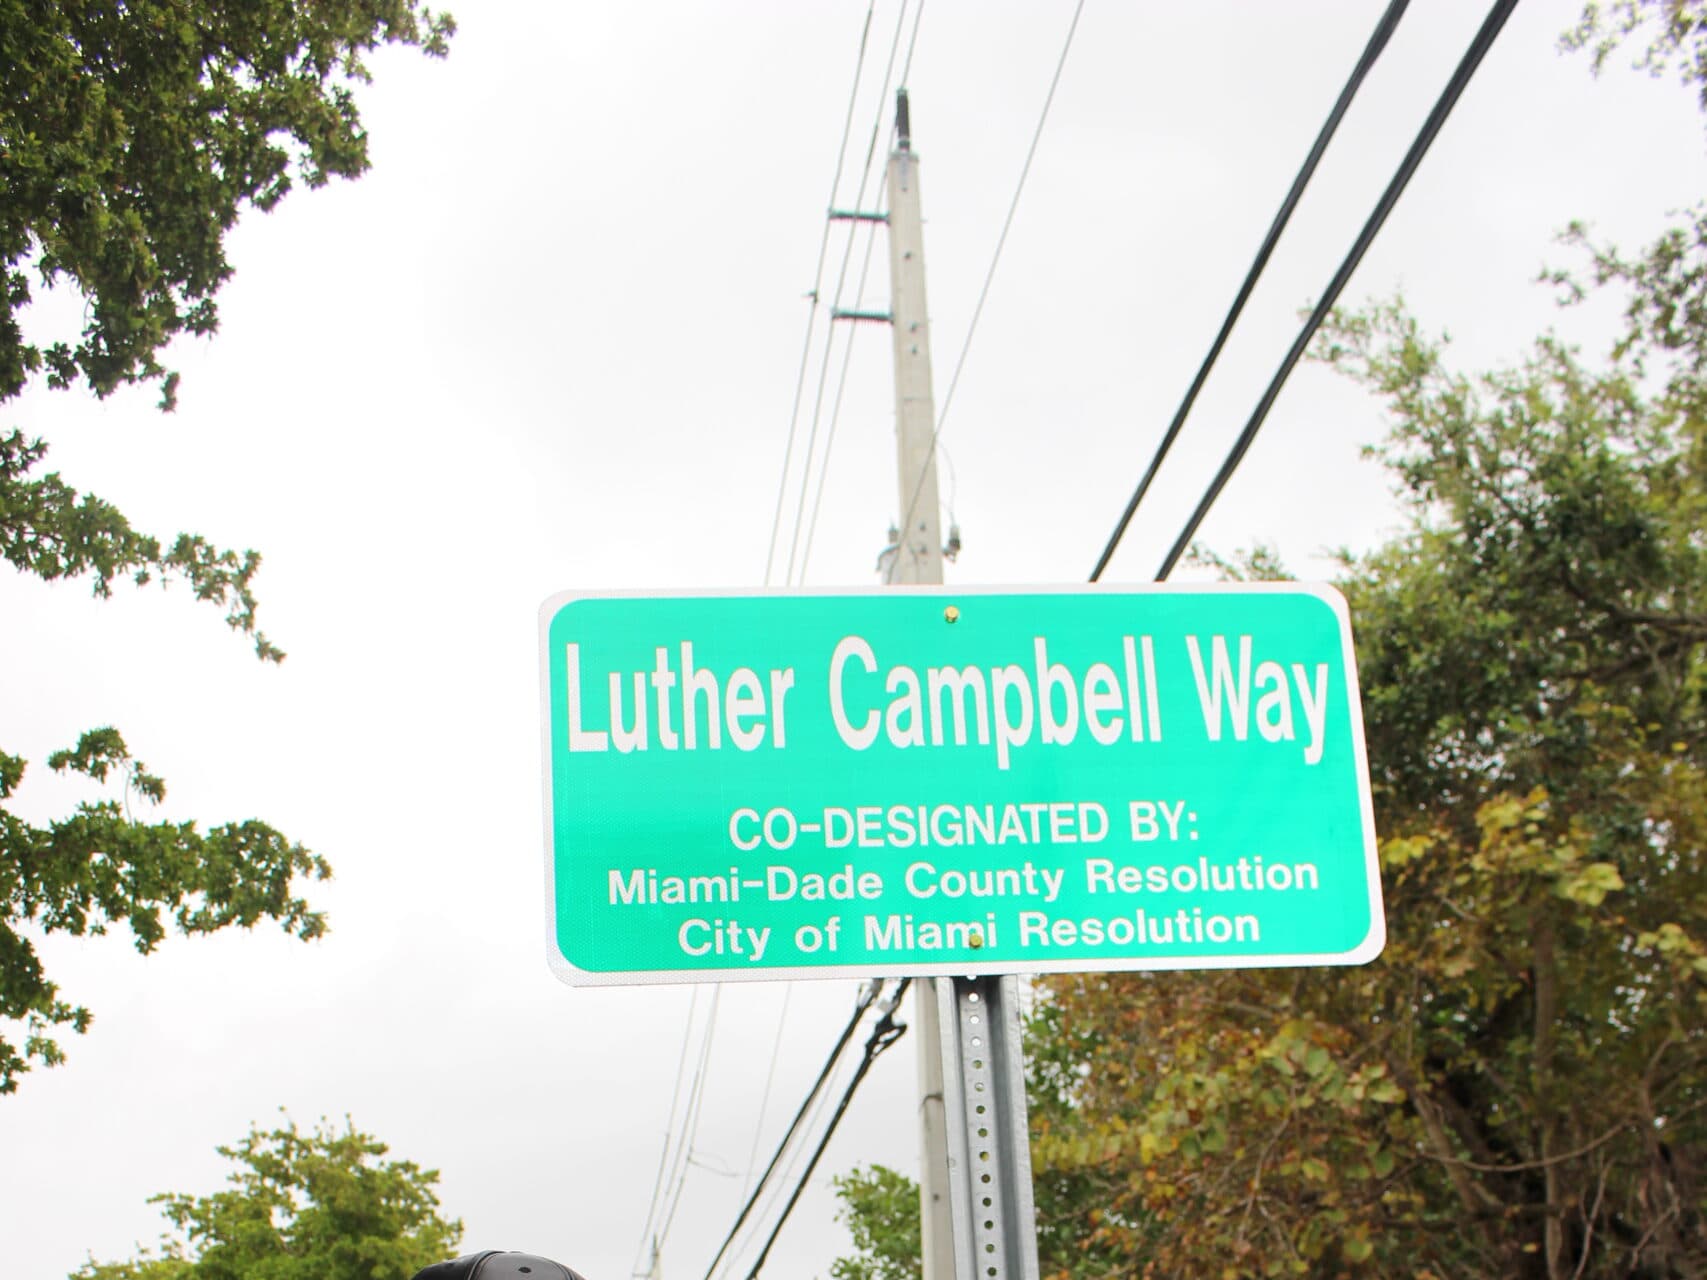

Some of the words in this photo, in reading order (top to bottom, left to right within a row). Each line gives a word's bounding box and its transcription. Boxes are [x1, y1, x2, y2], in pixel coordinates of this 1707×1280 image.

[567, 641, 794, 753] Luther
[829, 636, 1161, 769] Campbell
[1186, 635, 1328, 764] Way
[730, 802, 1108, 850] CO-DESIGNATED
[1130, 801, 1198, 841] BY:
[609, 865, 882, 904] Miami-Dade
[905, 862, 1064, 901] County
[1086, 856, 1318, 893] Resolution
[679, 919, 770, 960] City
[795, 917, 840, 952] of
[864, 913, 996, 950] Miami
[1020, 908, 1260, 946] Resolution
